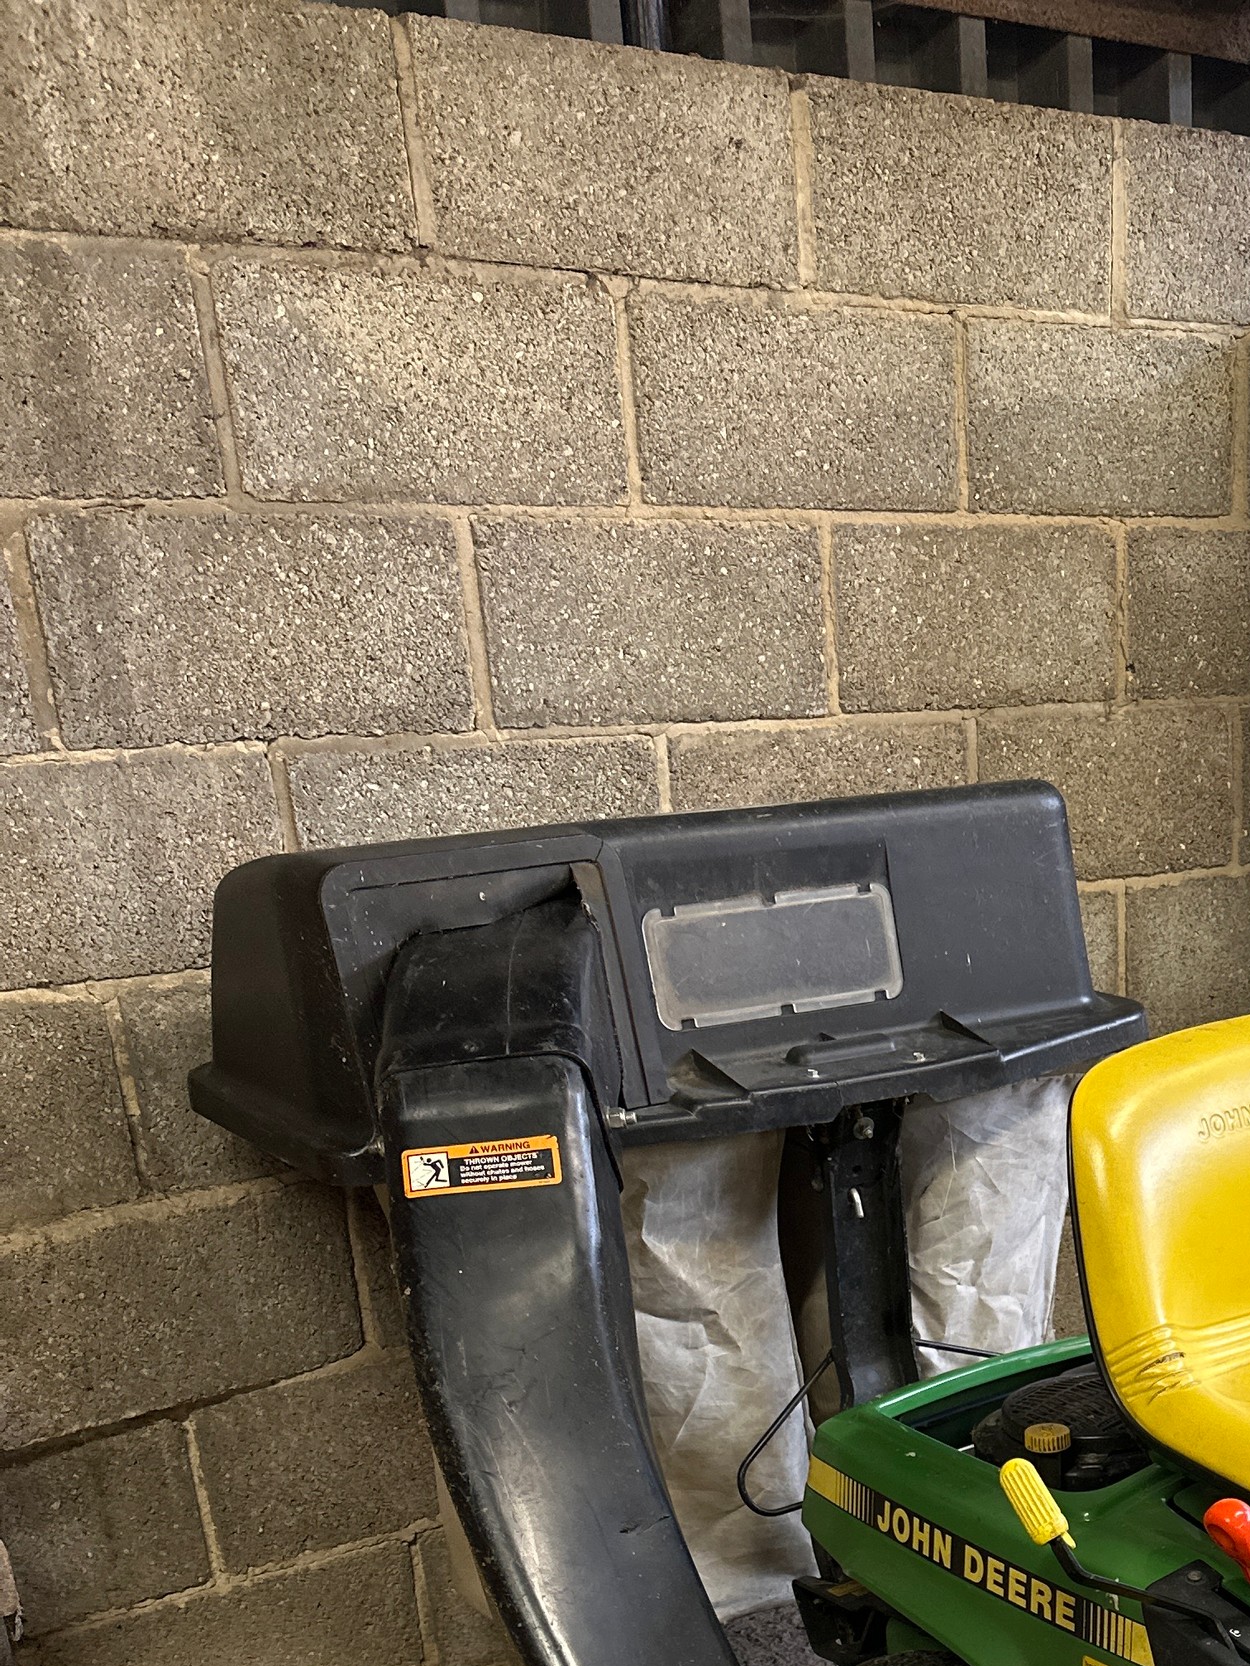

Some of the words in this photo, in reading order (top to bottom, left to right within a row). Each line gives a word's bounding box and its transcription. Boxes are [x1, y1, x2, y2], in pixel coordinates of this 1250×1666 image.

[480, 1141, 531, 1154] WARNING
[463, 1156, 500, 1165] THROWN
[501, 1152, 539, 1163] OBJECTS
[460, 1170, 486, 1178] without
[511, 1166, 524, 1174] and
[470, 1163, 482, 1171] not
[460, 1175, 490, 1185] securely
[499, 1174, 518, 1183] place
[877, 1500, 952, 1569] JOHN
[963, 1544, 1076, 1632] DEERE
